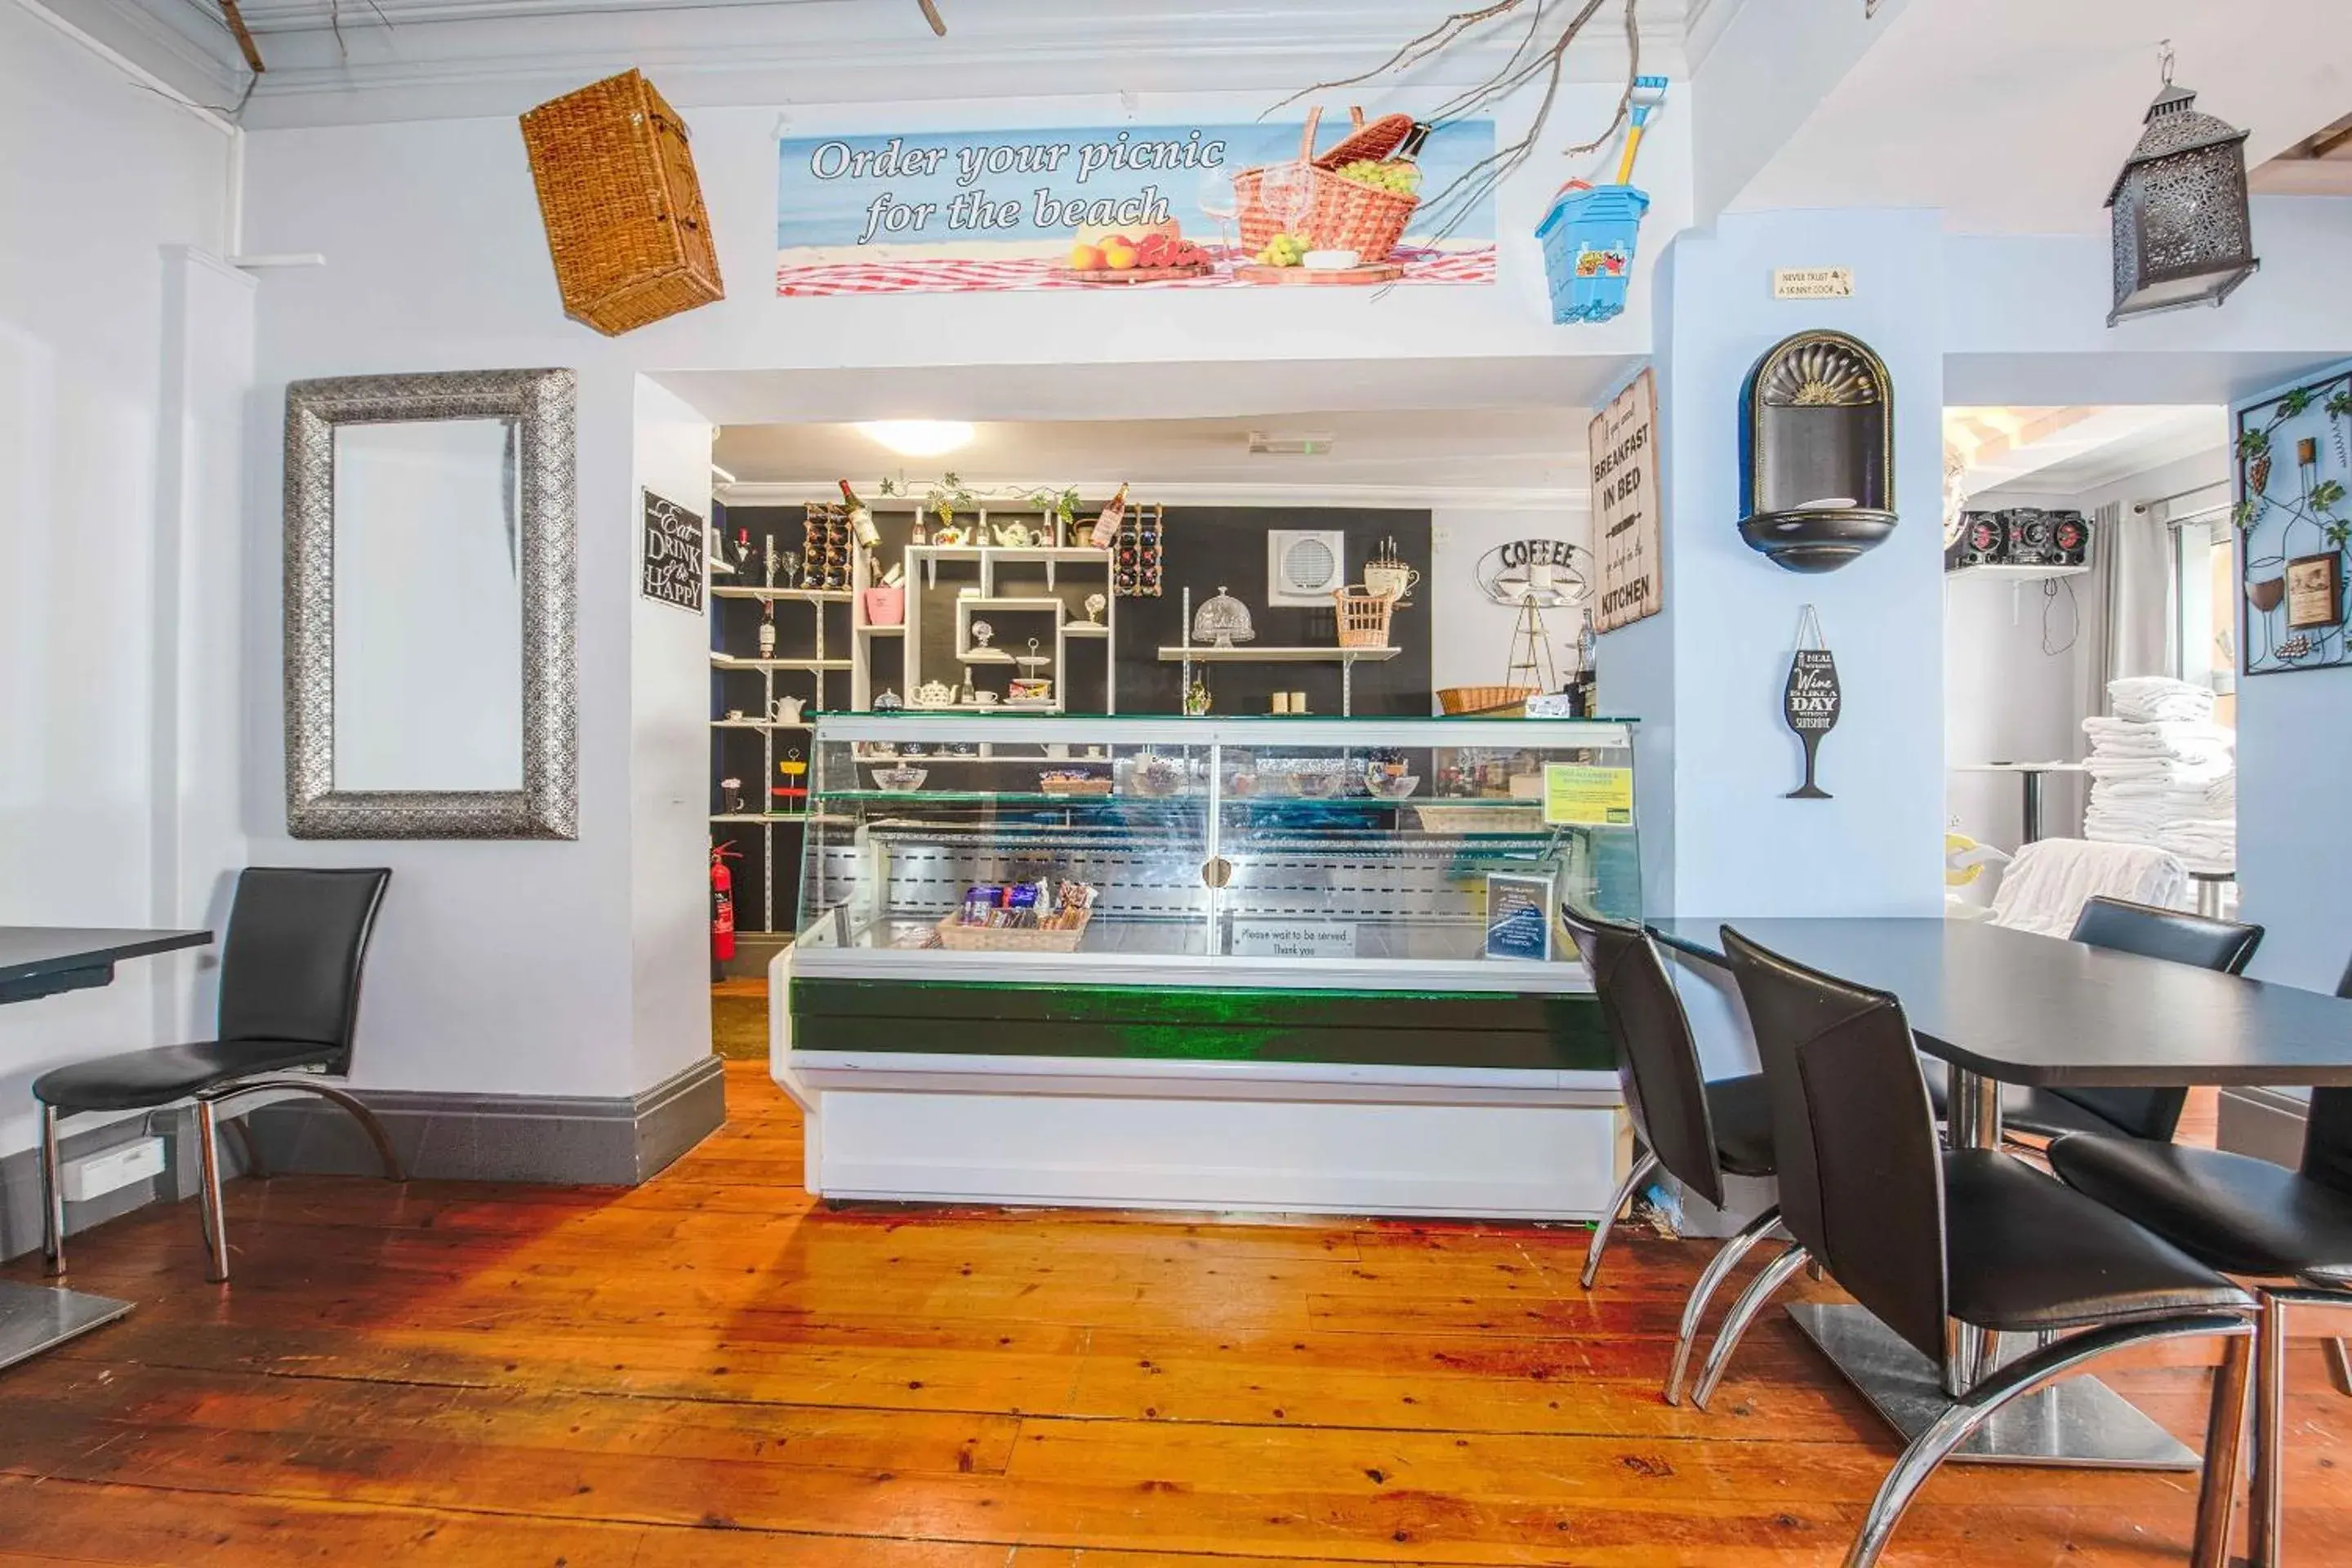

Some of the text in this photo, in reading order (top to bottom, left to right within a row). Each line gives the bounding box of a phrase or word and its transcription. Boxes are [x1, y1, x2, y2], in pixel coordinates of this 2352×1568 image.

[810, 131, 1226, 187] Order your picnic
[858, 185, 1169, 245] for the beach
[1782, 272, 1829, 282] NEVER TRUST
[1594, 422, 1648, 483] BREAKFAST
[1603, 466, 1641, 512] IN BED
[661, 513, 694, 542] Eat
[648, 528, 702, 576] DRINK
[1501, 540, 1577, 568] COFFEE
[647, 564, 702, 608] HAPPY
[1601, 573, 1650, 617] KITCHEN
[1793, 667, 1833, 690] Wine
[1790, 697, 1838, 711] DAY
[1241, 929, 1347, 941] Please wait to be served
[1273, 943, 1315, 956] Thank you
